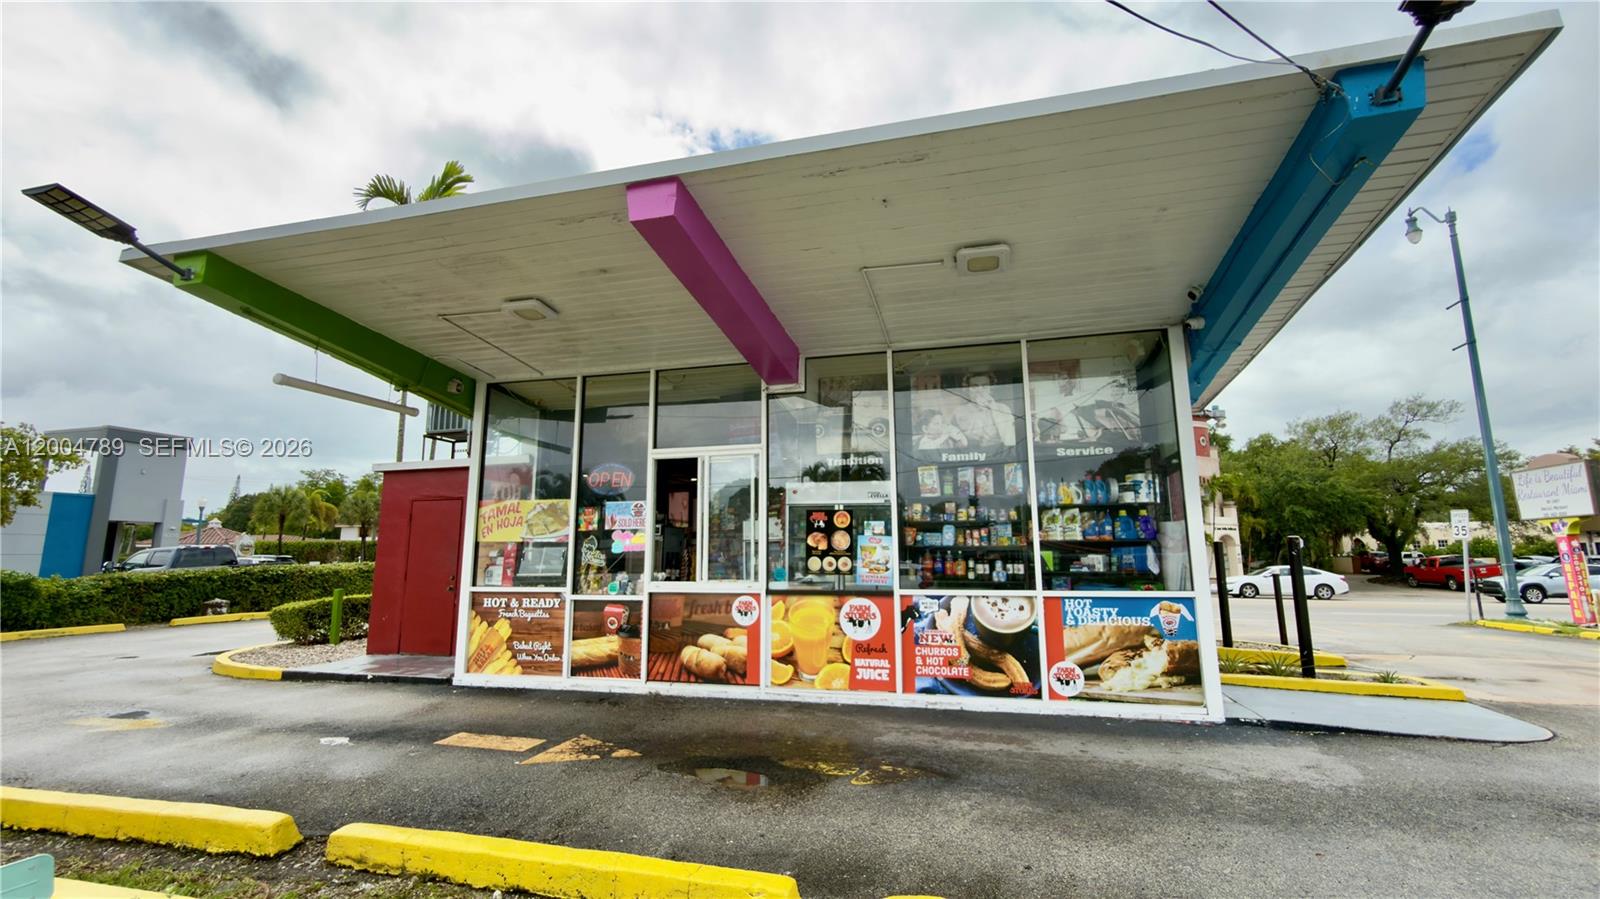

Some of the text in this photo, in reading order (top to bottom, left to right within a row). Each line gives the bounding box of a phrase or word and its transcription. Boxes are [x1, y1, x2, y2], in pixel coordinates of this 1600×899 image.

[941, 452, 987, 462] Family
[1056, 446, 1114, 457] Service
[826, 454, 884, 467] Tradition
[587, 471, 634, 488] OPEN
[1543, 464, 1582, 484] Beautiful
[1518, 486, 1559, 500] Restaurant
[480, 501, 522, 524] TAMAL
[481, 515, 523, 538] EN HOJA
[617, 518, 632, 528] SOLD
[1454, 525, 1468, 537] 35
[483, 597, 561, 608] HOT & READY
[1064, 598, 1092, 609] HOT
[688, 600, 725, 618] fresh
[848, 604, 871, 613] FARM
[1065, 607, 1119, 618] TOASTY
[843, 612, 877, 621] STORES
[1065, 616, 1076, 626] &
[918, 632, 955, 644] NEW
[855, 642, 888, 656] Refresh
[915, 646, 959, 656] CHURROS
[854, 658, 891, 668] NATURAL
[915, 656, 944, 666] & HOT
[856, 668, 890, 681] JUICE
[915, 666, 969, 677] CHOCOLATE
